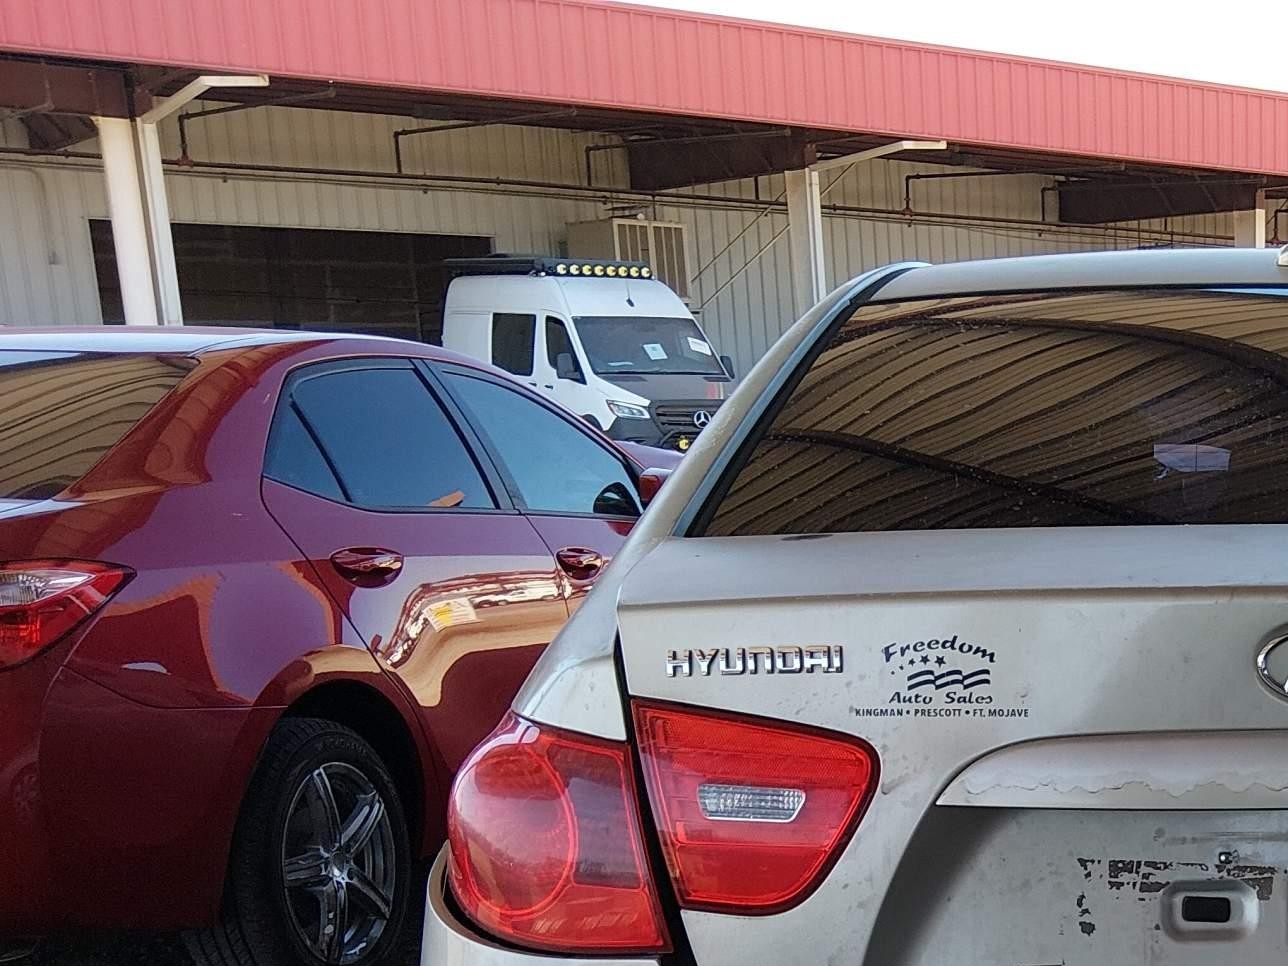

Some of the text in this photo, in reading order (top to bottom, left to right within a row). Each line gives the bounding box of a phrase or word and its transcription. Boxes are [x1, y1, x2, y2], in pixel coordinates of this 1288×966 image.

[882, 635, 996, 663] Freedom
[666, 645, 844, 678] HYUNDAI
[889, 691, 993, 705] Auto Sales
[855, 708, 1029, 718] KINGMAN PRESCOTT FT. MOJAVE
